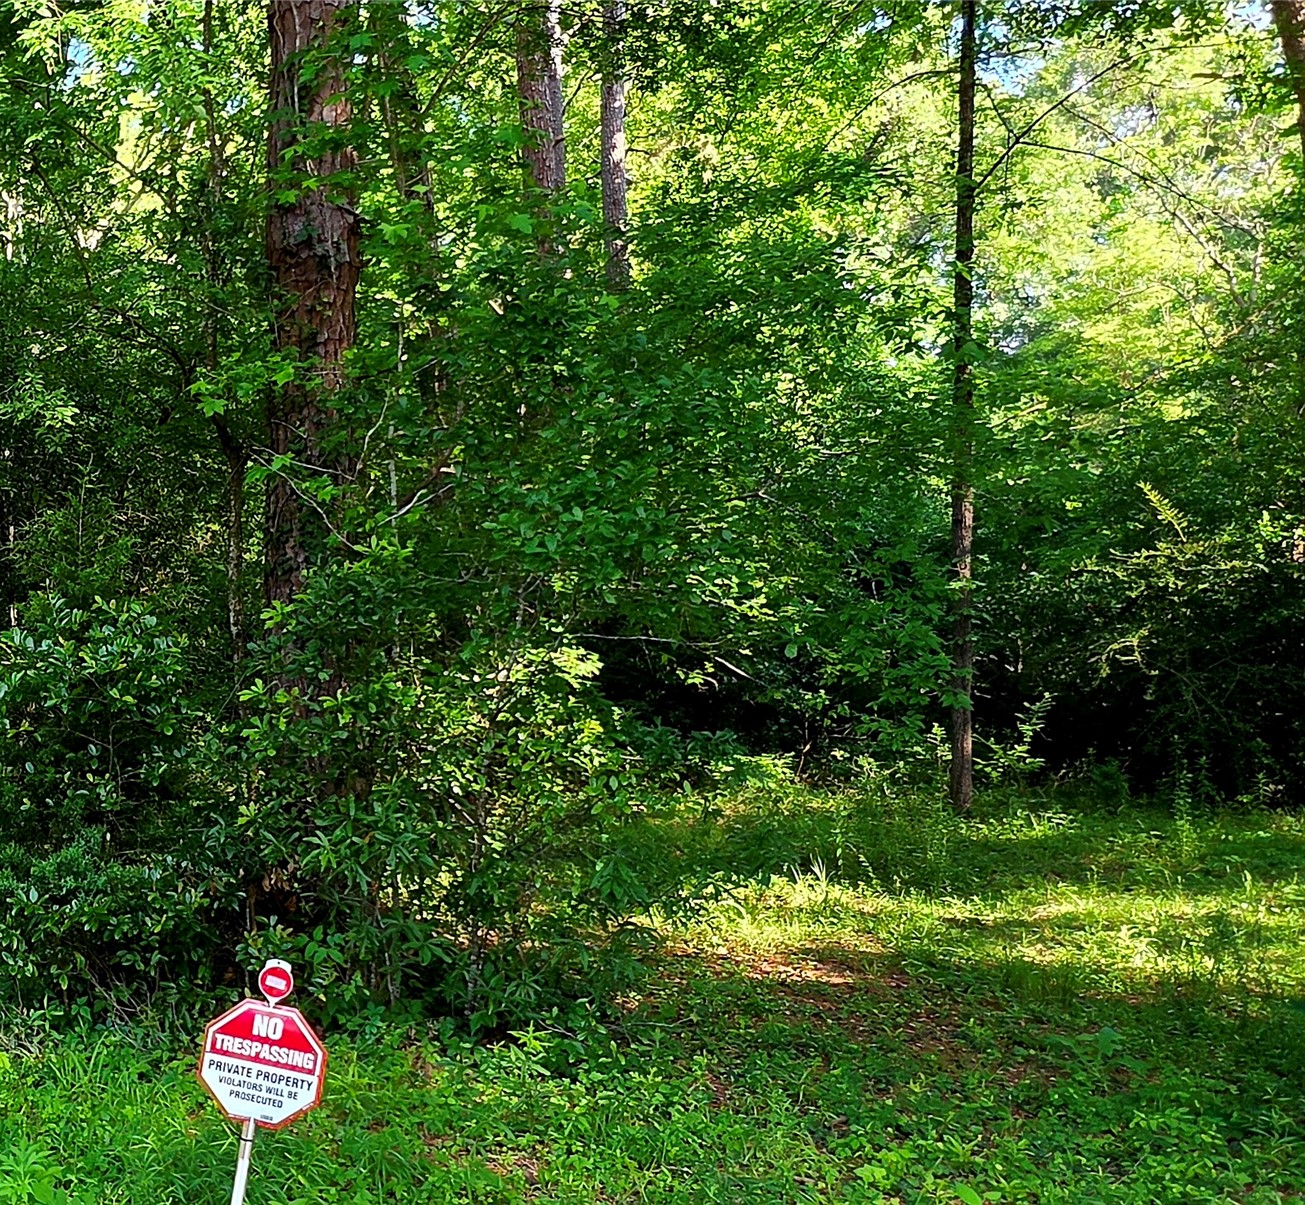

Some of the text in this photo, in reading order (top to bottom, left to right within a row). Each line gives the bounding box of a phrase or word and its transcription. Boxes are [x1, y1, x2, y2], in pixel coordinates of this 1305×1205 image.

[252, 1014, 284, 1040] NO
[215, 1033, 315, 1069] TRESPASSING
[208, 1060, 313, 1091] PRIVATE PROPERTY
[218, 1075, 299, 1100] VIOLATORS WILL BE
[229, 1090, 283, 1108] PROSECUTED
